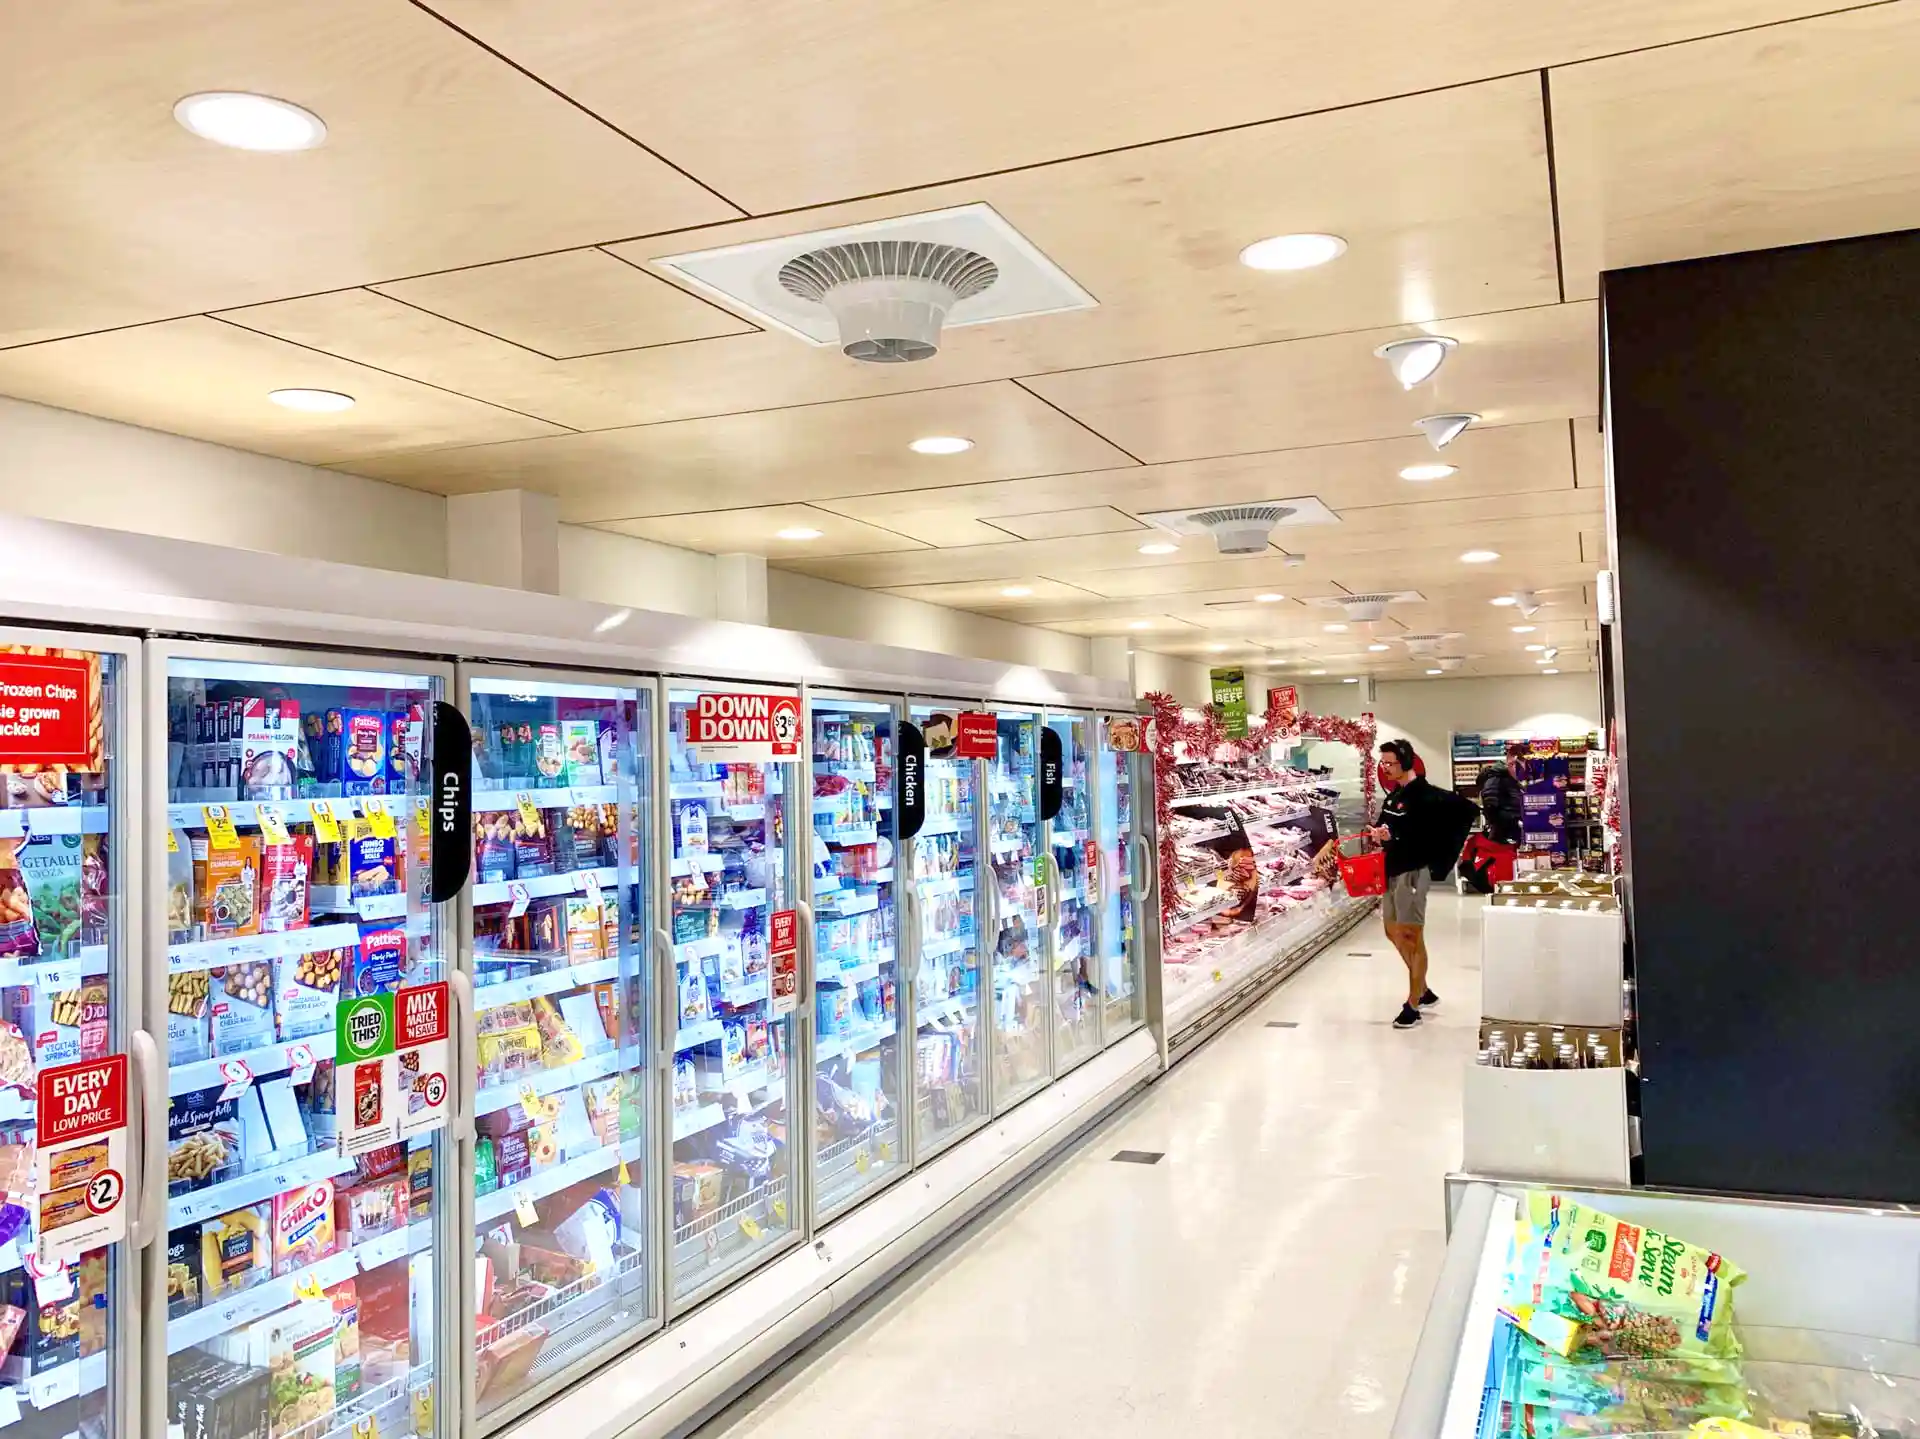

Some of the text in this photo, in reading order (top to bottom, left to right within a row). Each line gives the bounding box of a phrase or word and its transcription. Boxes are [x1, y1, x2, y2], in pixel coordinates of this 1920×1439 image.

[45, 684, 78, 702] Chips
[1215, 691, 1243, 702] BEEF
[20, 706, 60, 723] grown
[700, 696, 769, 718] DOWN
[354, 717, 380, 729] Patties
[700, 719, 769, 740] DOWN
[905, 755, 917, 806] Chicken
[1046, 763, 1056, 785] Fish
[438, 772, 460, 831] Chips
[775, 916, 792, 928] EVERY
[366, 933, 402, 949] Patties
[406, 991, 437, 1015] MIX
[351, 1012, 381, 1029] TRIED
[406, 1009, 437, 1027] MATCH
[352, 1026, 380, 1042] THIS?
[416, 1023, 437, 1036] SAVE
[53, 1067, 112, 1098] EVERY
[64, 1089, 102, 1116] DAY
[53, 1108, 112, 1133] LOW PRICE
[190, 1109, 215, 1126] Spring
[90, 1179, 112, 1205] $2
[279, 1187, 327, 1232] CHIKO
[1639, 1240, 1661, 1287] Serve
[1657, 1234, 1686, 1297] Steam
